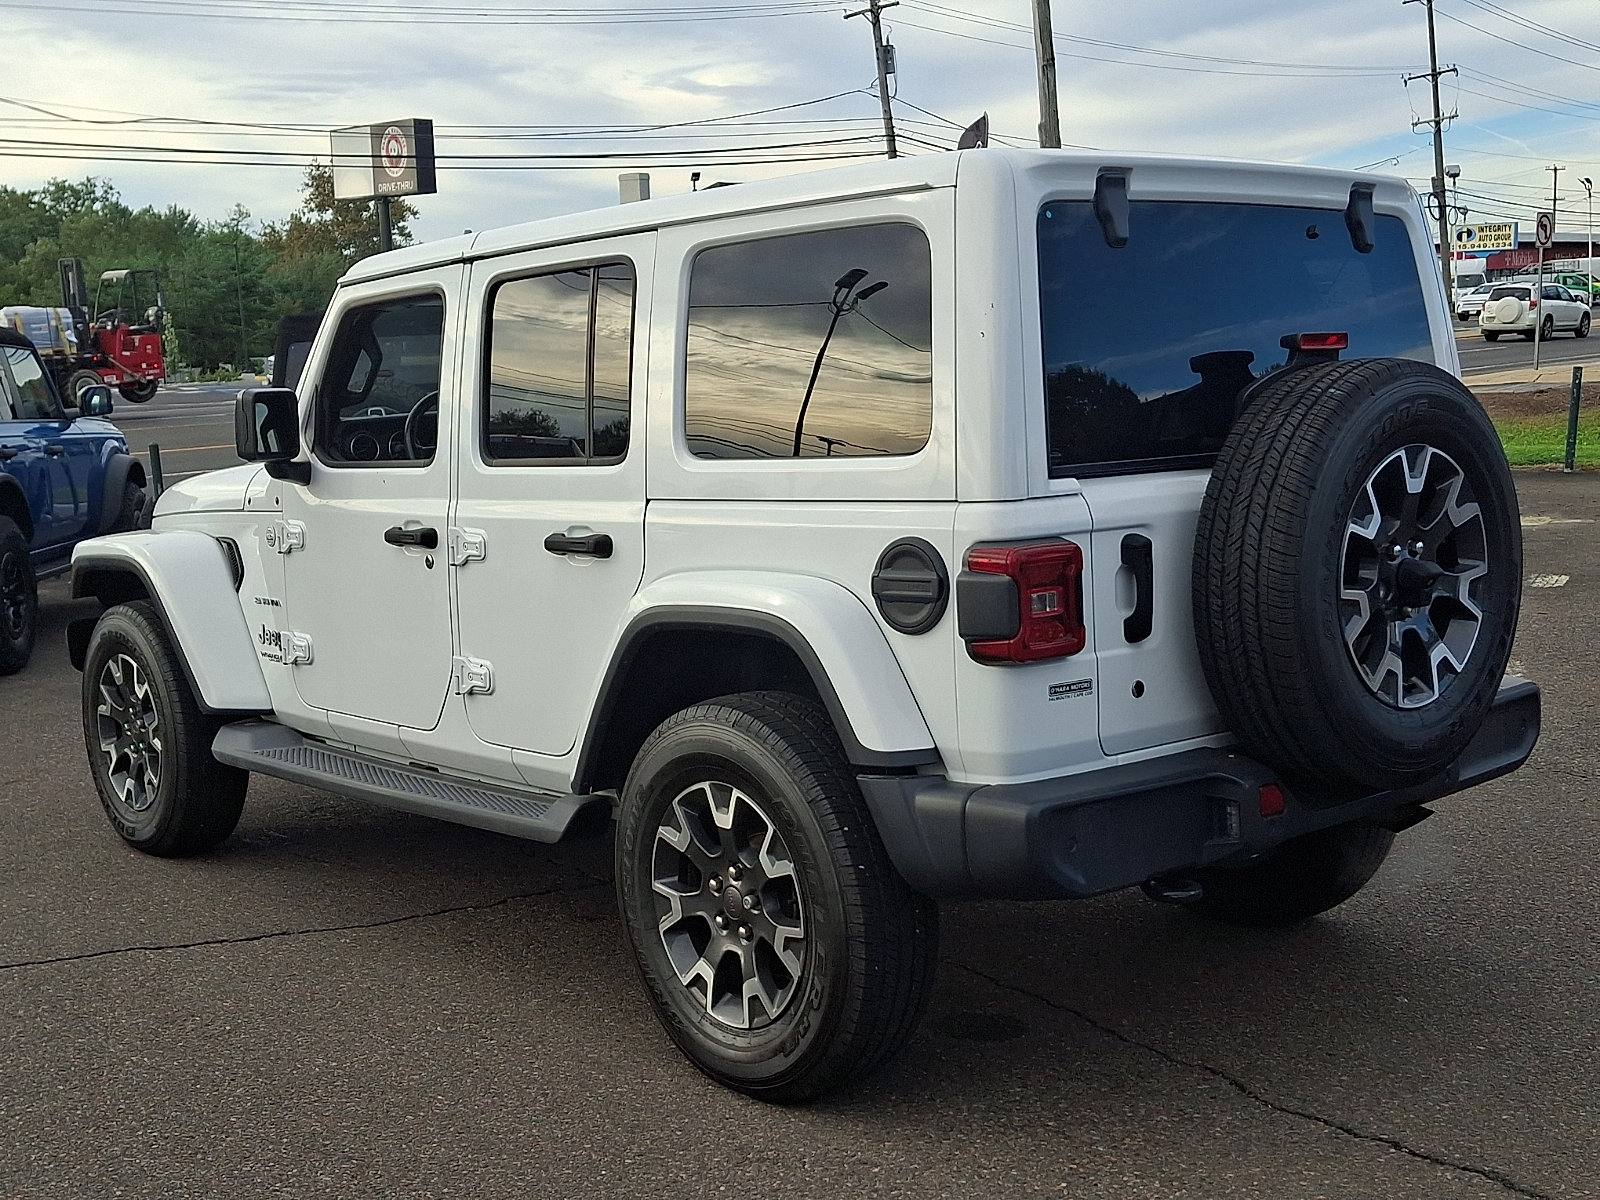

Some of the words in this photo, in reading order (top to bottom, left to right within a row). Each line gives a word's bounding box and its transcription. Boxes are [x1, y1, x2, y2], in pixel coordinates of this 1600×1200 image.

[378, 181, 414, 193] DRIVE-THRU
[1477, 224, 1512, 233] INTEGRITY
[1478, 234, 1493, 242] AUTO
[1493, 233, 1512, 242] GROUP
